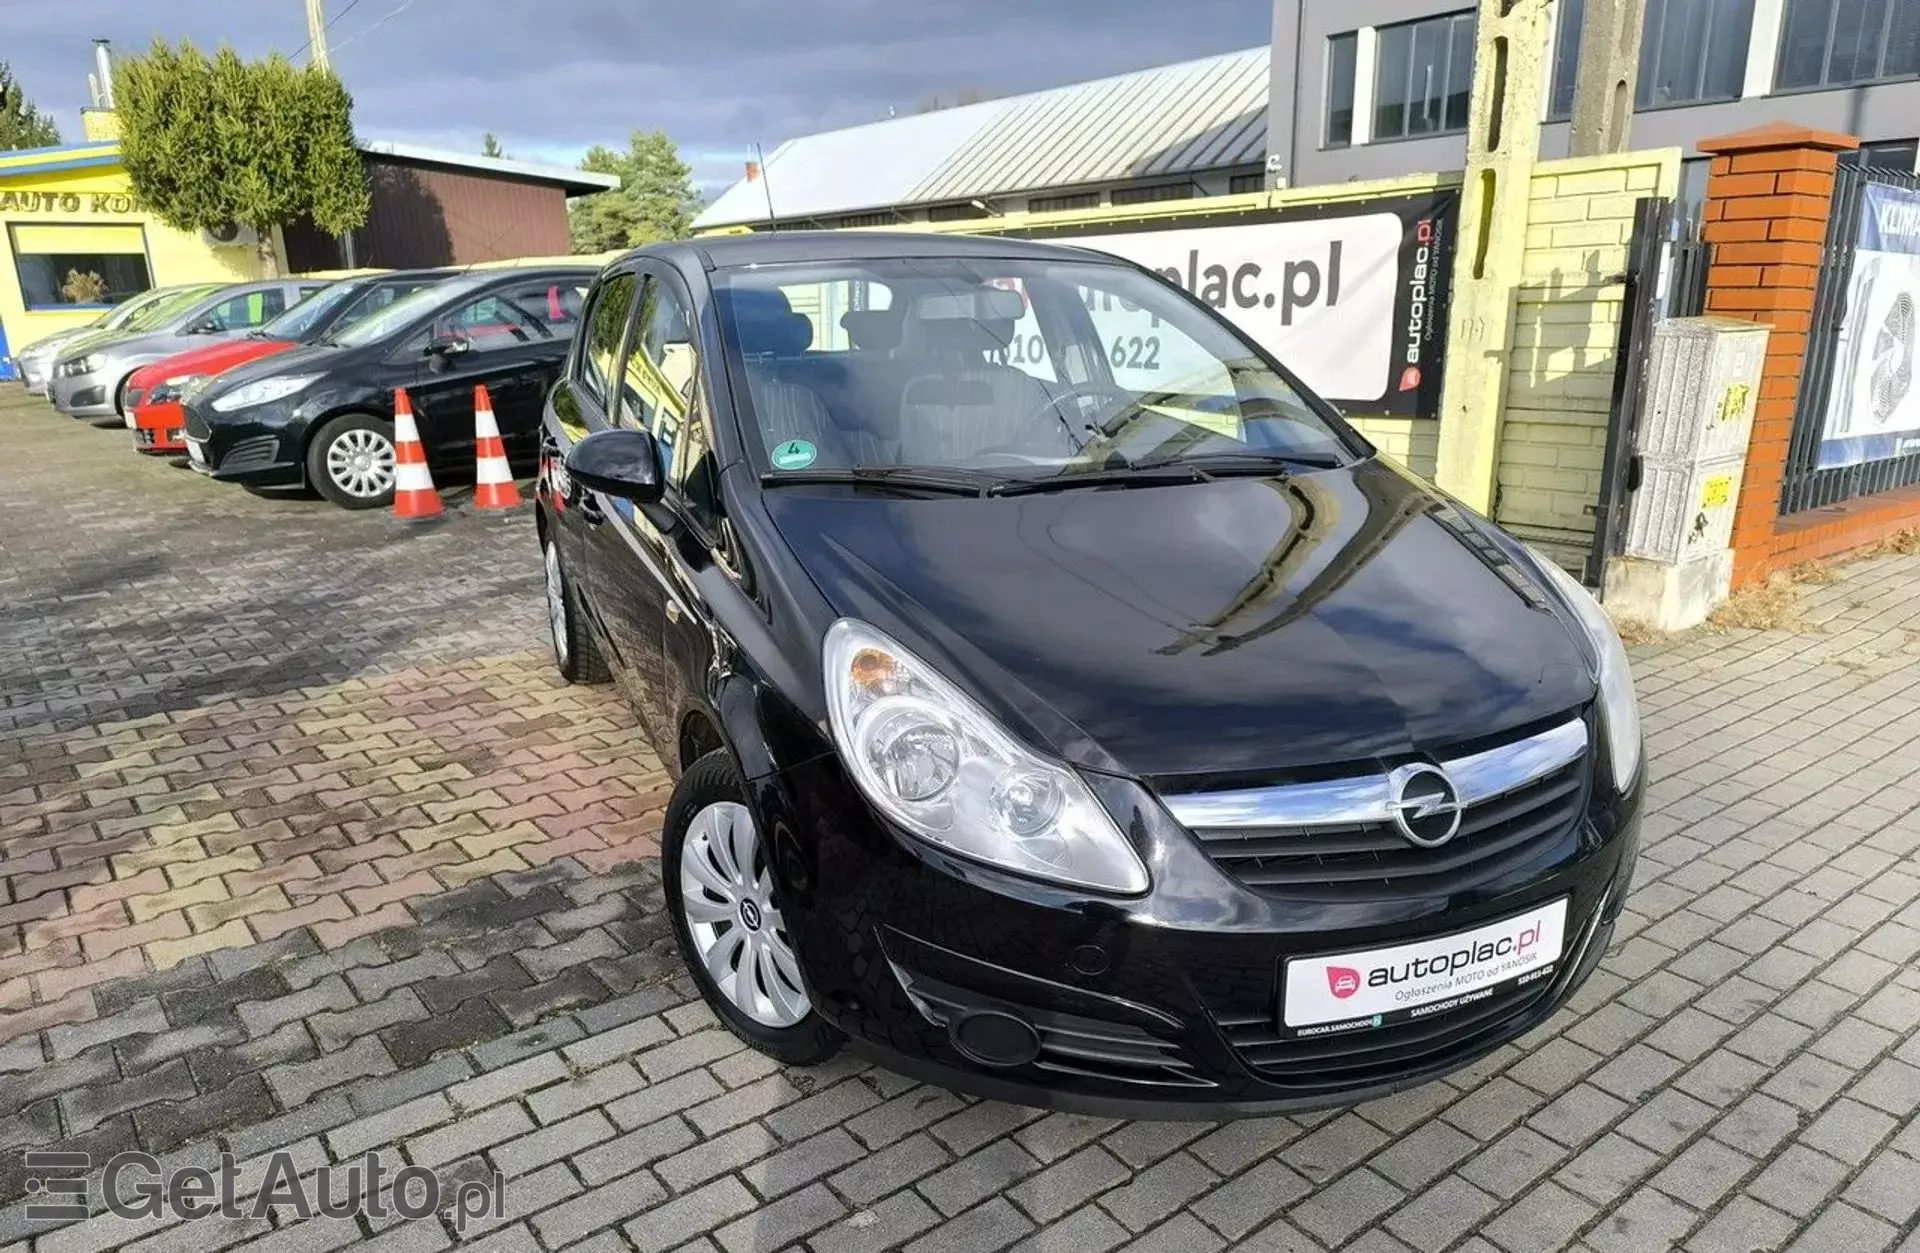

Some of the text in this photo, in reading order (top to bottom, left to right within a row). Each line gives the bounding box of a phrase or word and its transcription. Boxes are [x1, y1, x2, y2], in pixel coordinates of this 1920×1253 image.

[0, 191, 81, 213] AUTO
[1407, 219, 1433, 363] autoplac.pl
[1110, 335, 1161, 370] 622
[787, 442, 801, 455] 4
[1368, 919, 1541, 988] autoplac.pl
[1455, 970, 1485, 987] MOTO
[1487, 964, 1499, 977] od
[1410, 998, 1459, 1018] SAMOCHODY
